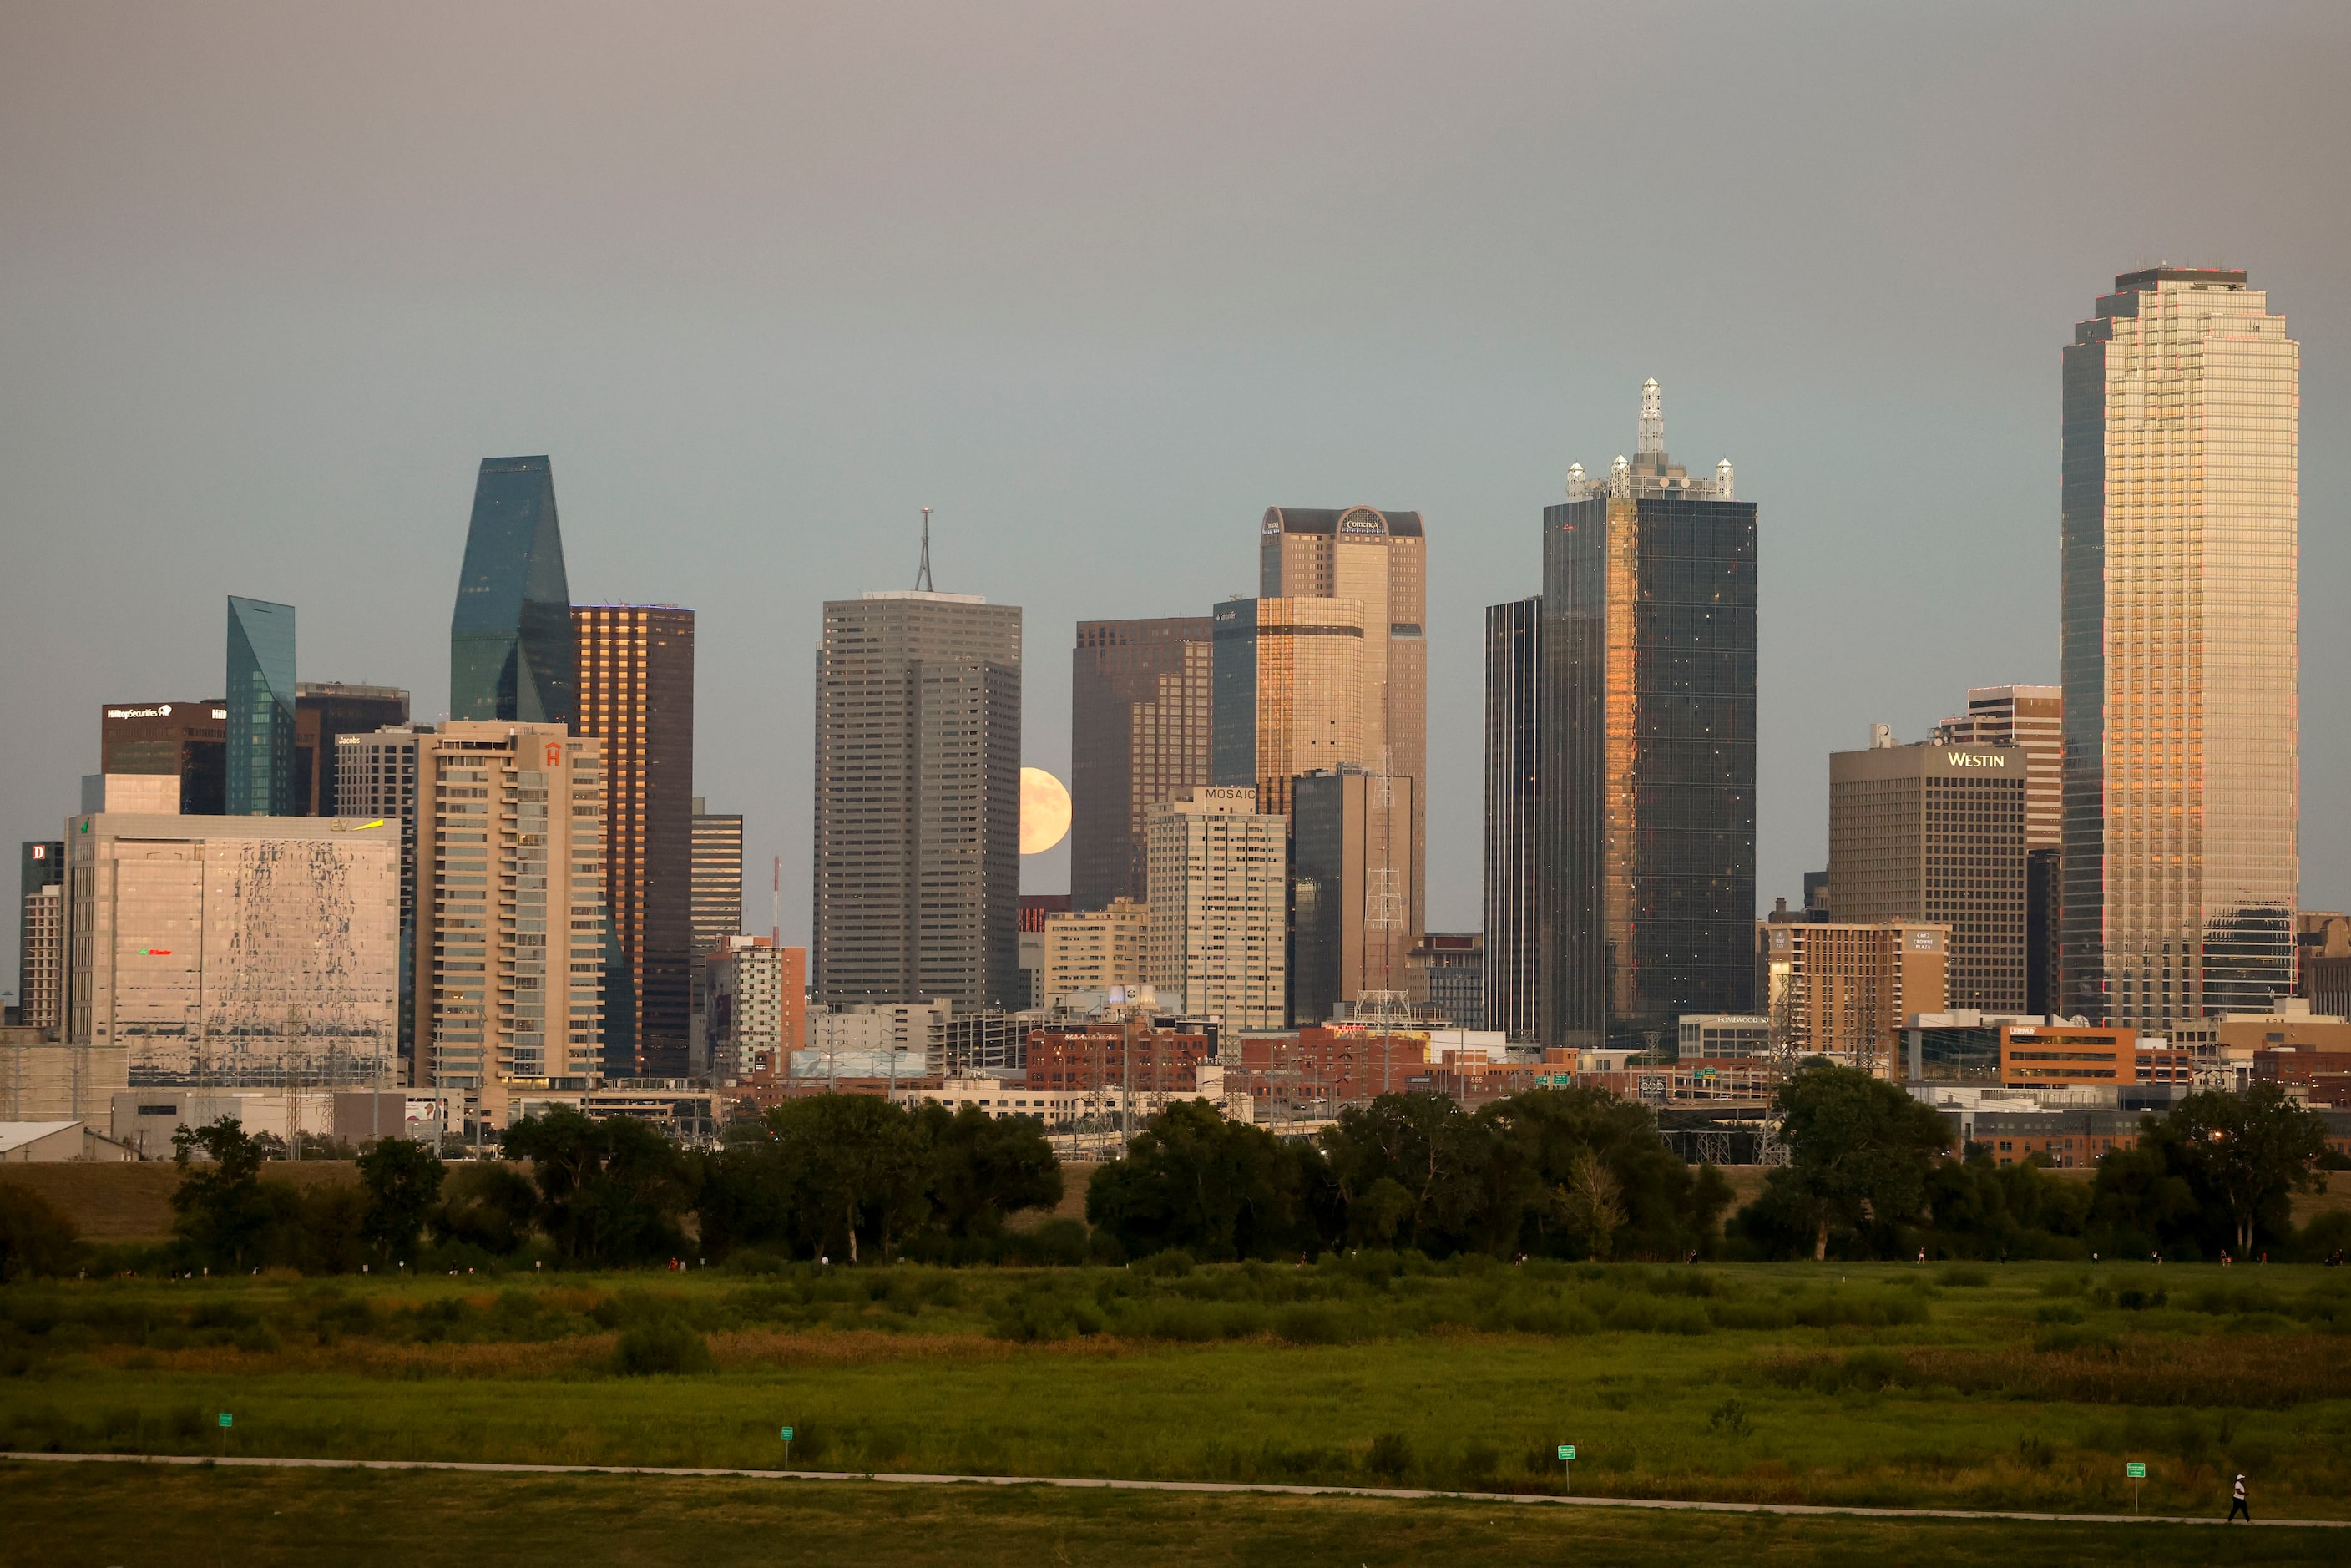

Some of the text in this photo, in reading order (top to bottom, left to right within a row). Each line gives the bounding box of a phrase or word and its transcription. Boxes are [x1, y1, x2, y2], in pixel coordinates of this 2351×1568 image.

[1948, 752, 2004, 767] WESTIN
[1206, 789, 1256, 799] MOSAIC
[331, 819, 349, 832] EY
[34, 846, 44, 859] D
